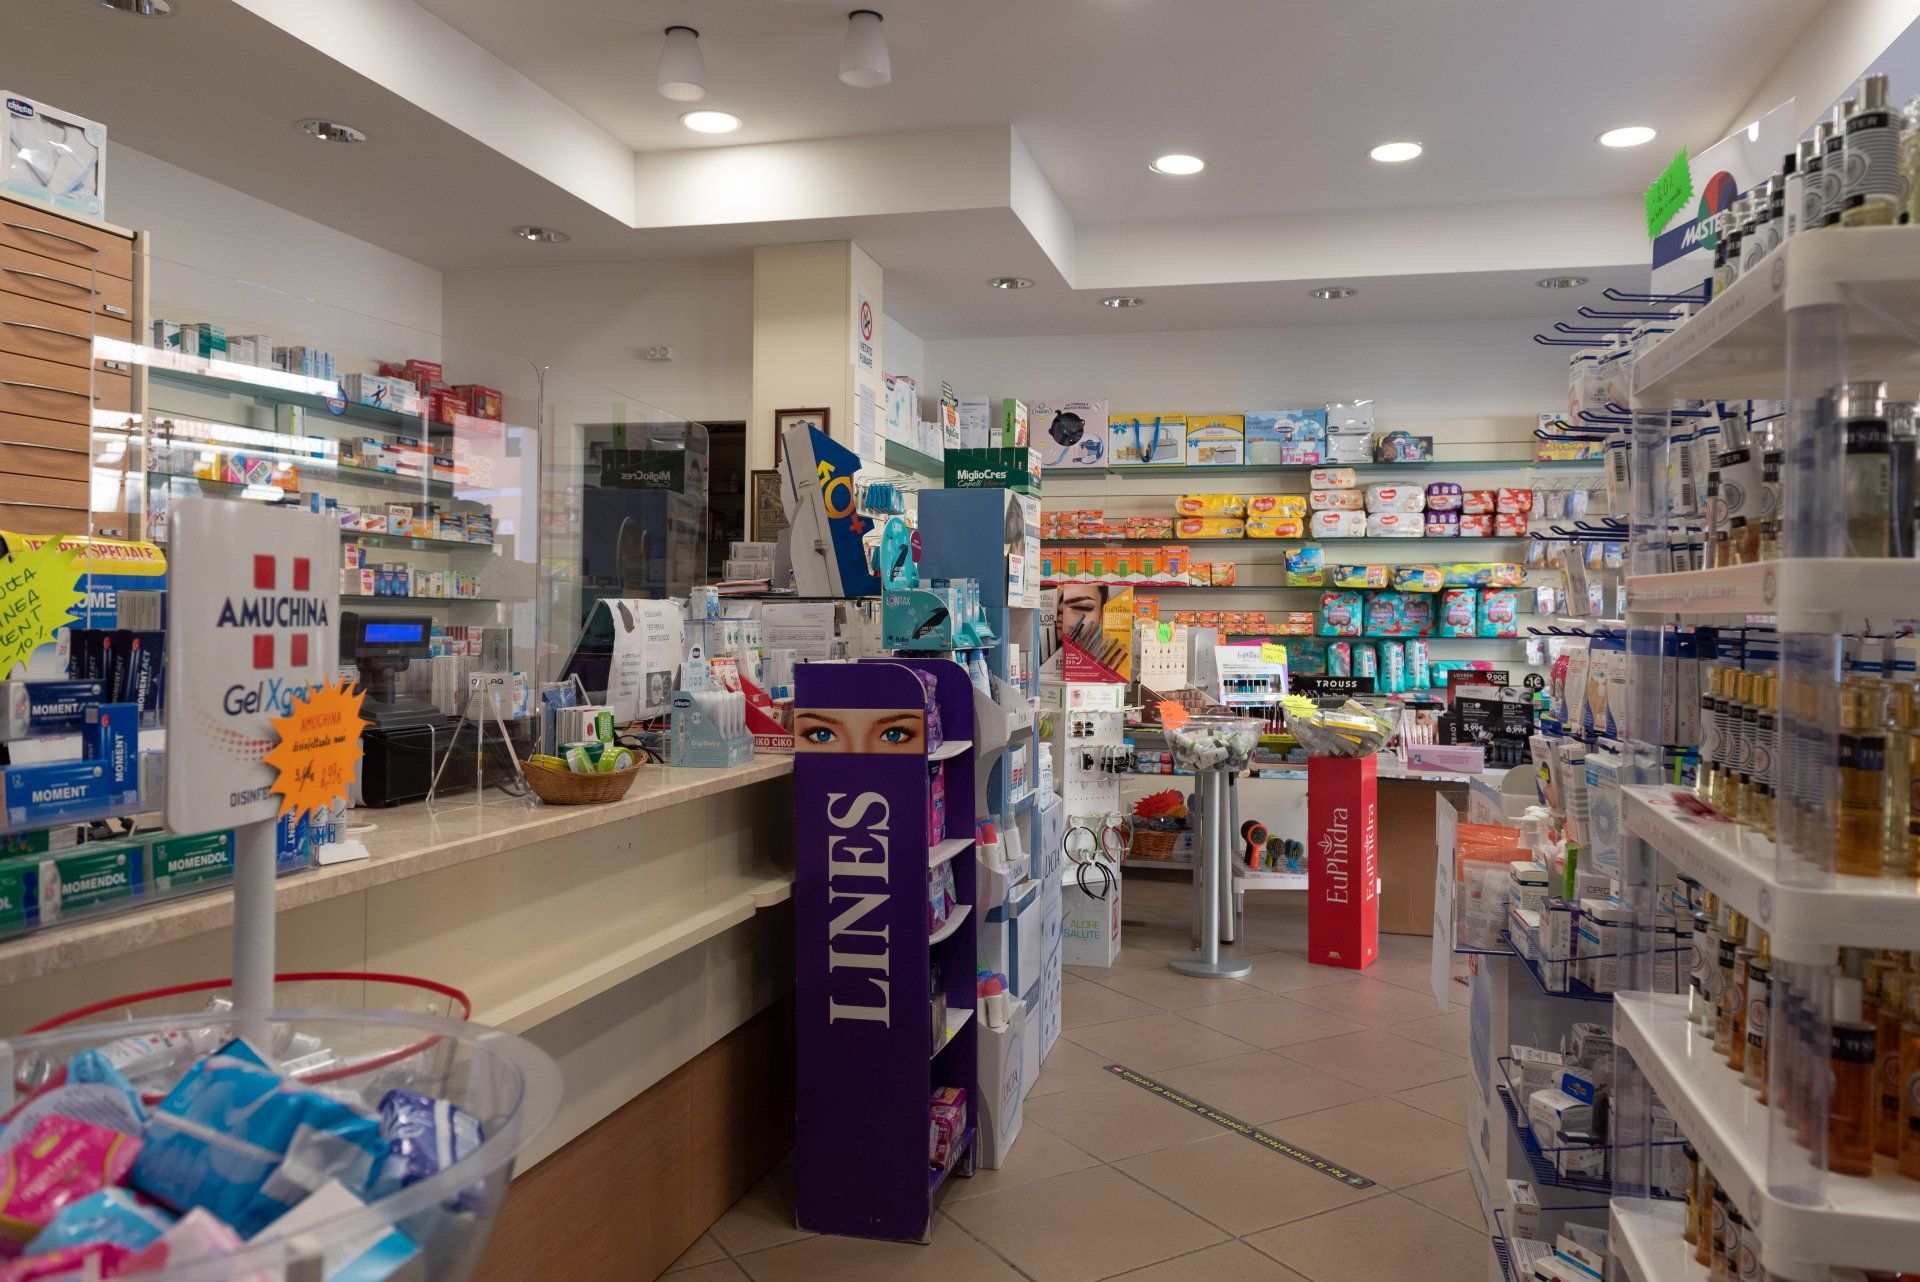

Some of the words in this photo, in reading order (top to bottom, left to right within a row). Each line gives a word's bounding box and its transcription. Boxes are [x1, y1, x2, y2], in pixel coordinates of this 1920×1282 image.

[957, 469, 1007, 482] MiglioCres
[216, 597, 328, 627] AMUCHINA
[1316, 680, 1358, 688] TROUSS
[1486, 673, 1507, 681] 9,90€
[224, 680, 263, 716] Gel
[301, 711, 341, 732] AMUCHINA
[1463, 723, 1484, 732] 5,99€
[1506, 726, 1527, 734] 6,99€
[755, 737, 770, 746] iKO
[772, 737, 793, 747] CiKO
[115, 734, 124, 782] MOMENT
[32, 786, 87, 803] MOMENT
[168, 851, 228, 872] MOMENDOL
[1326, 807, 1348, 904] EuPhidra
[62, 873, 128, 895] MOMENDOL
[1587, 885, 1611, 894] cero
[827, 791, 891, 1029] LINES
[1063, 929, 1100, 940] SALUTE
